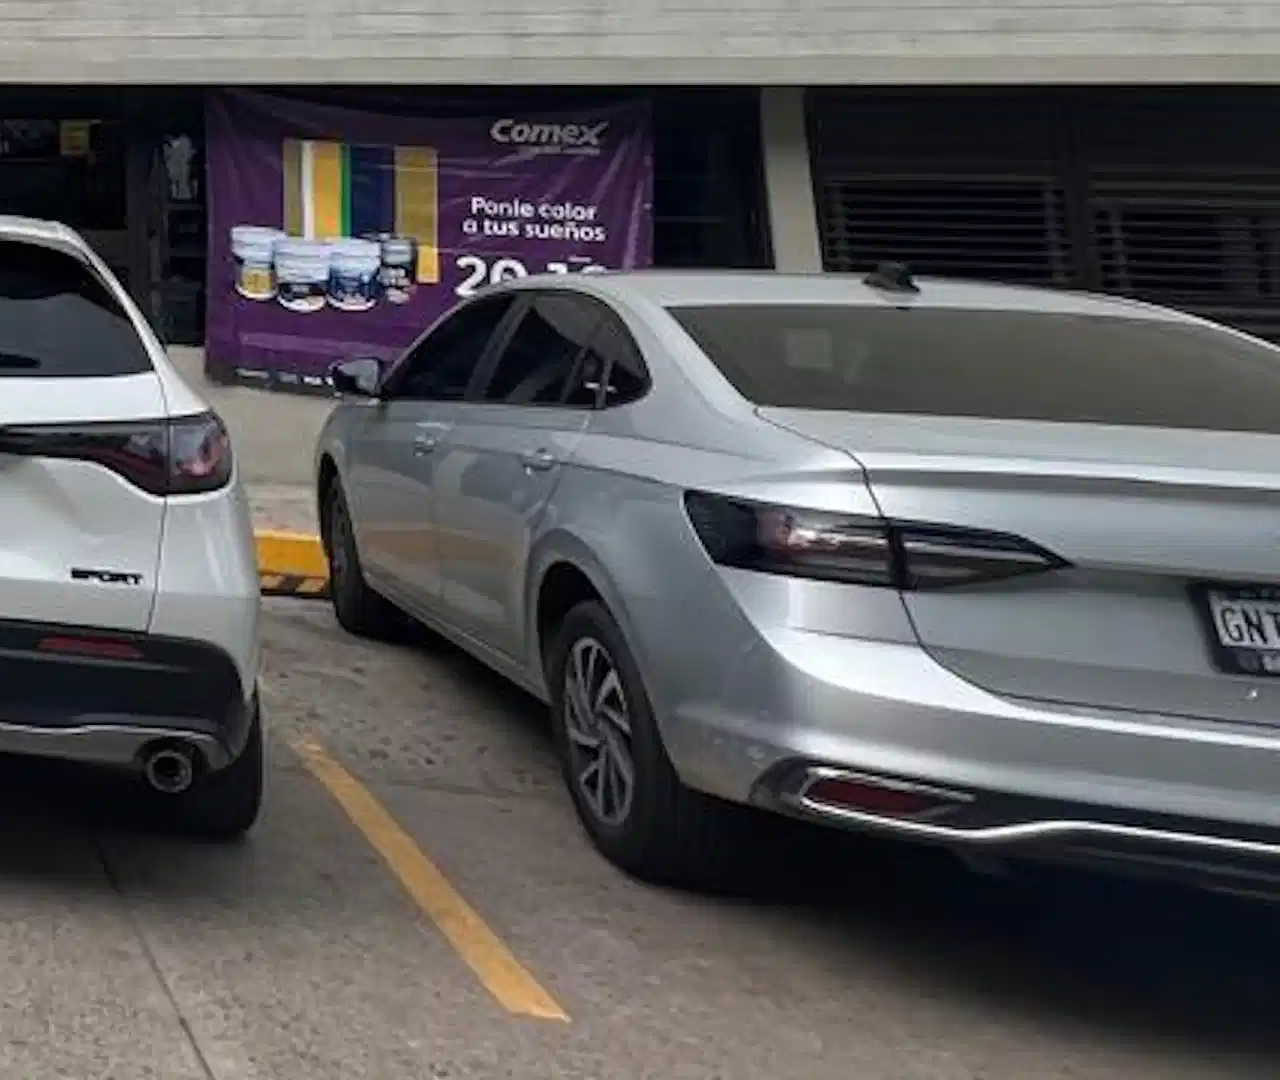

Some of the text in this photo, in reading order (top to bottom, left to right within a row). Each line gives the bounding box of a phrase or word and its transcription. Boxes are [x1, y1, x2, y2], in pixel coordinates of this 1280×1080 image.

[490, 119, 609, 145] Comex
[471, 196, 598, 221] Ponle color
[462, 218, 606, 241] a tus sueños
[70, 568, 144, 585] SPORT
